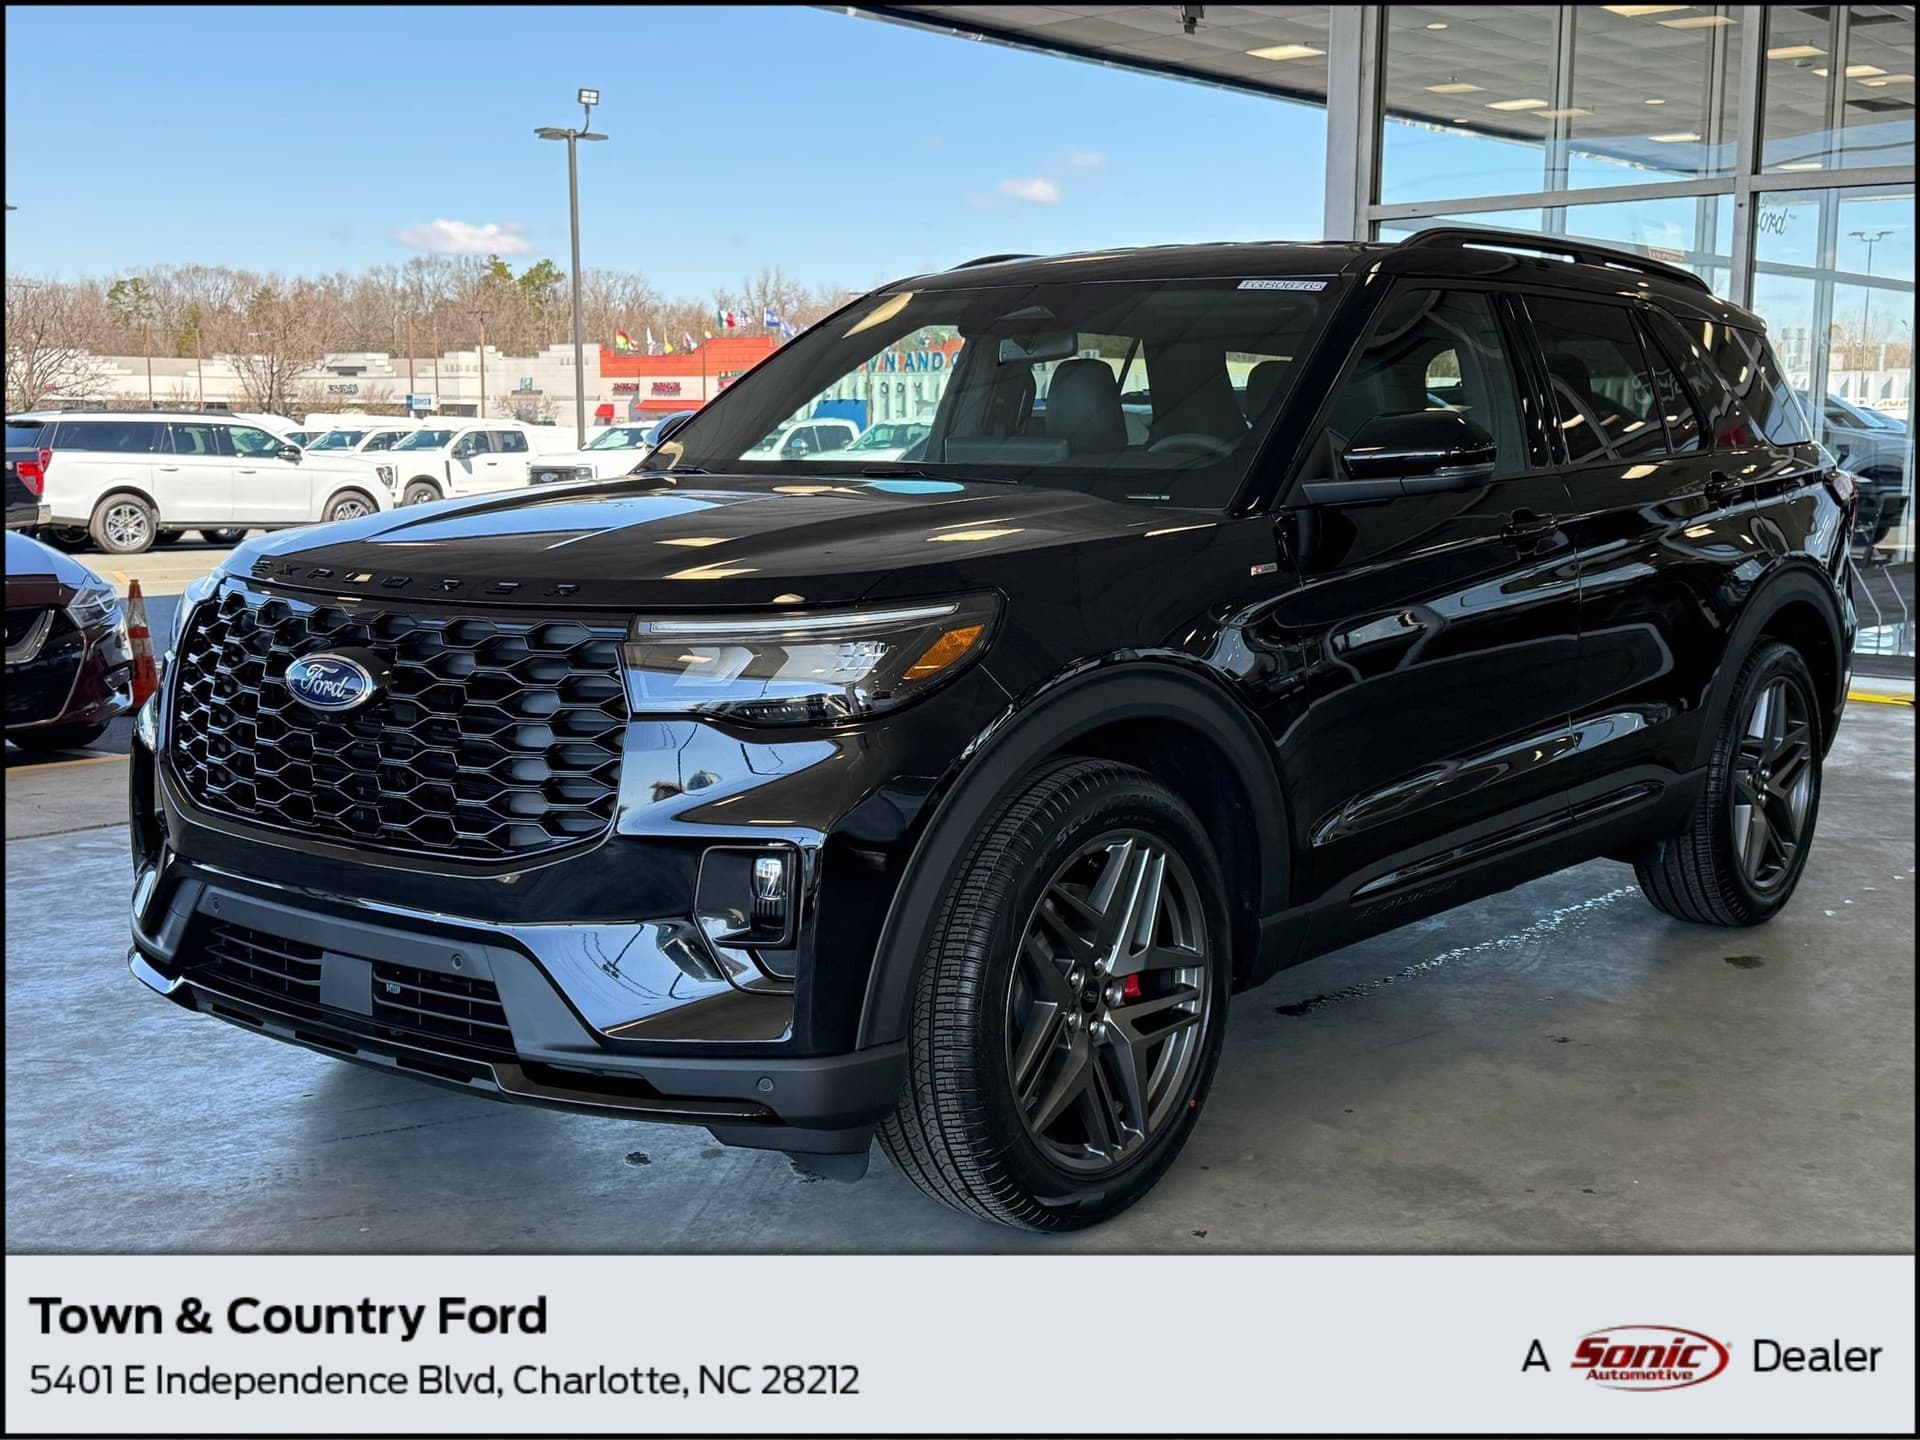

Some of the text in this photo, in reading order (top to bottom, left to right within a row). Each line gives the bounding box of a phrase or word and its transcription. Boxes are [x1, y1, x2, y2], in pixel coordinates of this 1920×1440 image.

[1759, 207, 1788, 235] ord
[904, 351, 943, 373] AND
[880, 380, 923, 396] ODY
[250, 559, 582, 598] EXPLORER
[300, 663, 349, 698] Ford
